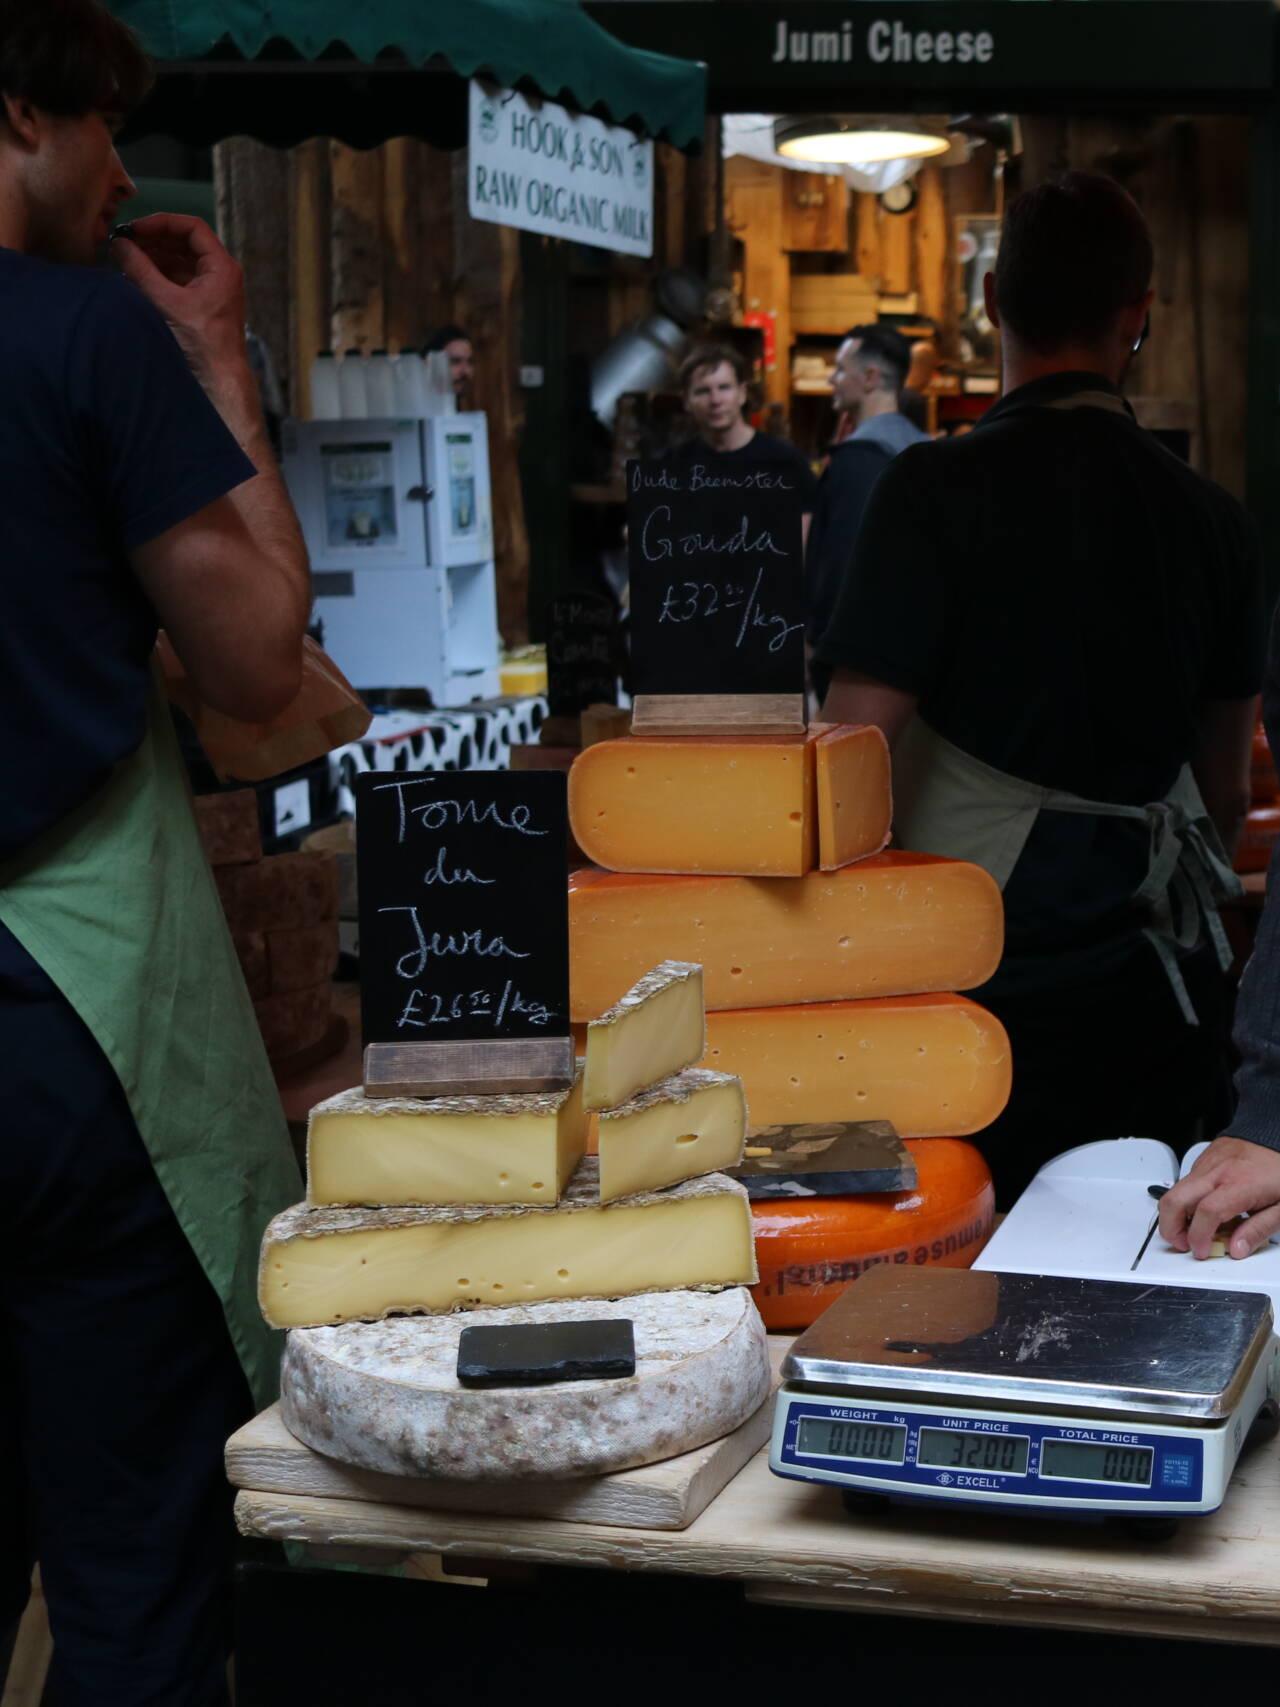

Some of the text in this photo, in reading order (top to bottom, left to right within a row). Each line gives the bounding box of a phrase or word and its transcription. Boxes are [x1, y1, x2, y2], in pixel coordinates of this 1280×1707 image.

[772, 19, 994, 63] Jumi Cheese
[511, 111, 624, 177] HOOK & SON
[476, 165, 648, 241] RAW ORGANIC MILK
[642, 504, 790, 562] Gouda
[372, 777, 549, 843] Tome
[424, 846, 496, 884] du
[377, 906, 531, 979] Jura
[830, 1408, 906, 1424] WEIGHT kg
[942, 1418, 1009, 1432] UNIT PRICE
[1059, 1429, 1139, 1444] TOTAL PRICE
[957, 1475, 1000, 1489] EXCELL
